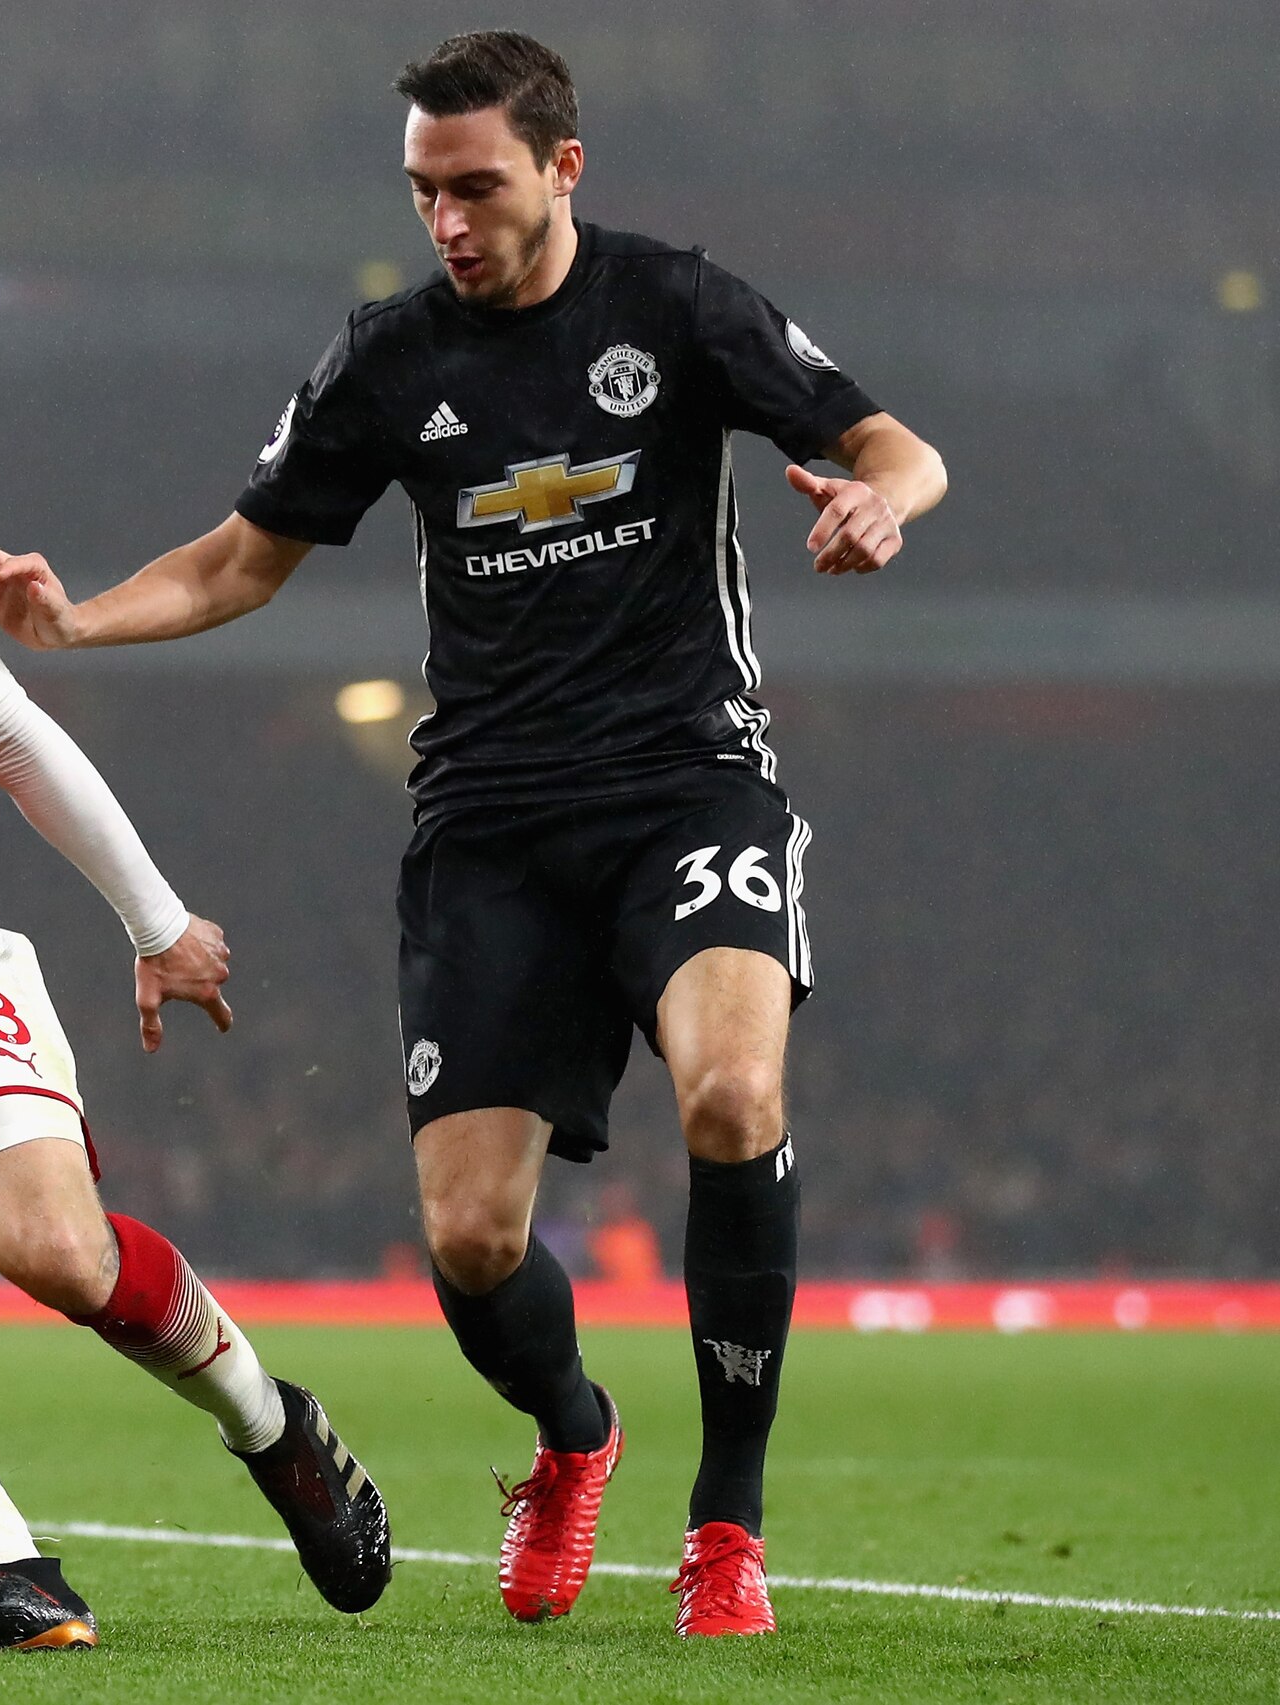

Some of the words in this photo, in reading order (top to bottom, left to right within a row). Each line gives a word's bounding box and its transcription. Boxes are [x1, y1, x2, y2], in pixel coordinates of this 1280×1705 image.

[594, 350, 650, 379] MANCHESTER
[609, 396, 649, 412] UNITED
[420, 423, 468, 442] adidas
[466, 517, 656, 577] CHEVROLET
[674, 845, 783, 921] 36
